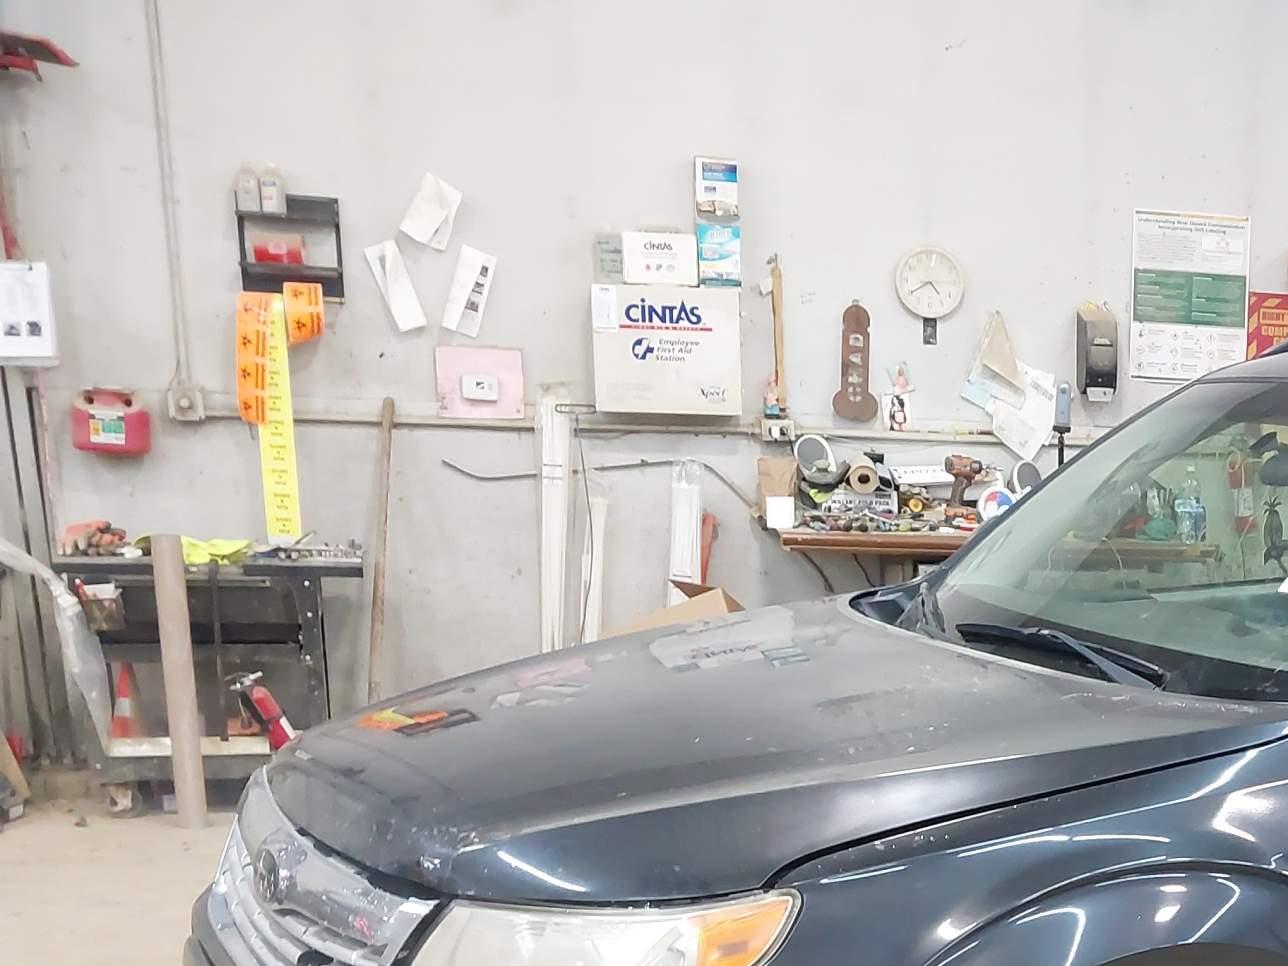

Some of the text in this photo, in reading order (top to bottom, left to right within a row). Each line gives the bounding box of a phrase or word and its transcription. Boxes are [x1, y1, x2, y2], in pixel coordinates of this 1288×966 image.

[658, 337, 700, 347] Employee
[657, 346, 693, 355] First Aid
[655, 354, 686, 363] Station
